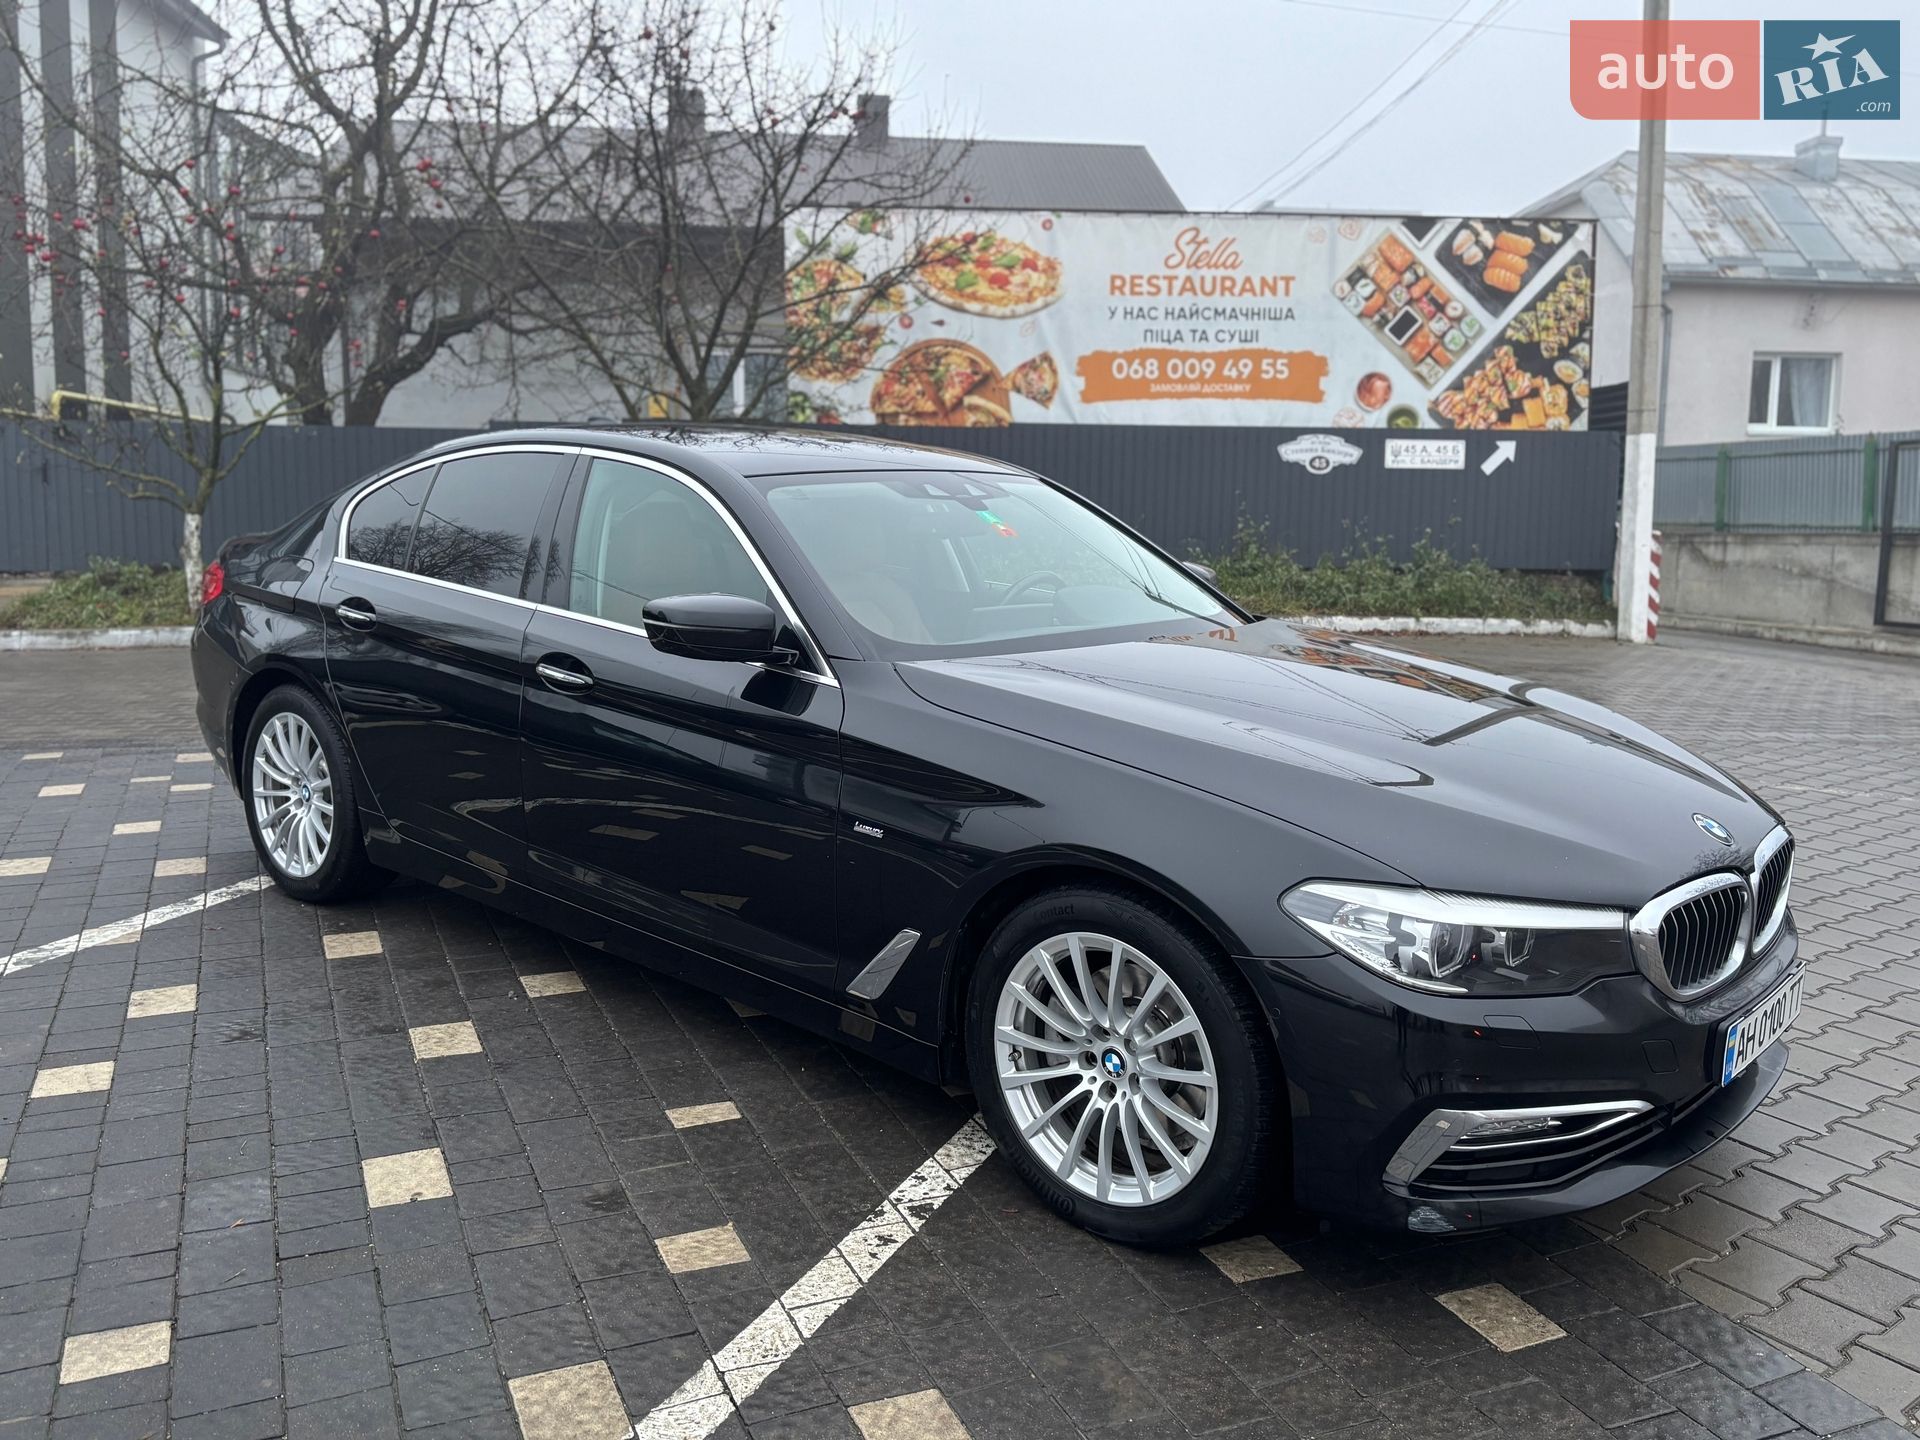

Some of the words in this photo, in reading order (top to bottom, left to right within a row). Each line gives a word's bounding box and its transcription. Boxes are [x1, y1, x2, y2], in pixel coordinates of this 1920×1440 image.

[1164, 226, 1243, 270] Stella
[1109, 275, 1296, 297] RESTAURANT
[1108, 306, 1118, 321] У
[1124, 306, 1158, 321] НАС
[1165, 303, 1295, 321] НАЙСМАЧНІША
[1144, 329, 1184, 345] ПІЦА
[1189, 329, 1209, 343] ТА
[1215, 329, 1259, 343] СУШІ
[1112, 358, 1159, 379] 068
[1167, 358, 1215, 379] 009
[1223, 358, 1253, 379] 49
[1261, 358, 1289, 379] 55
[1202, 383, 1251, 393] ДОСТАВКУ
[1403, 445, 1416, 454] 45
[1435, 445, 1448, 454] 45
[1452, 445, 1460, 454] Б
[1735, 1017, 1758, 1069] AH
[1759, 992, 1787, 1048] 0100
[1790, 974, 1804, 1019] TT
